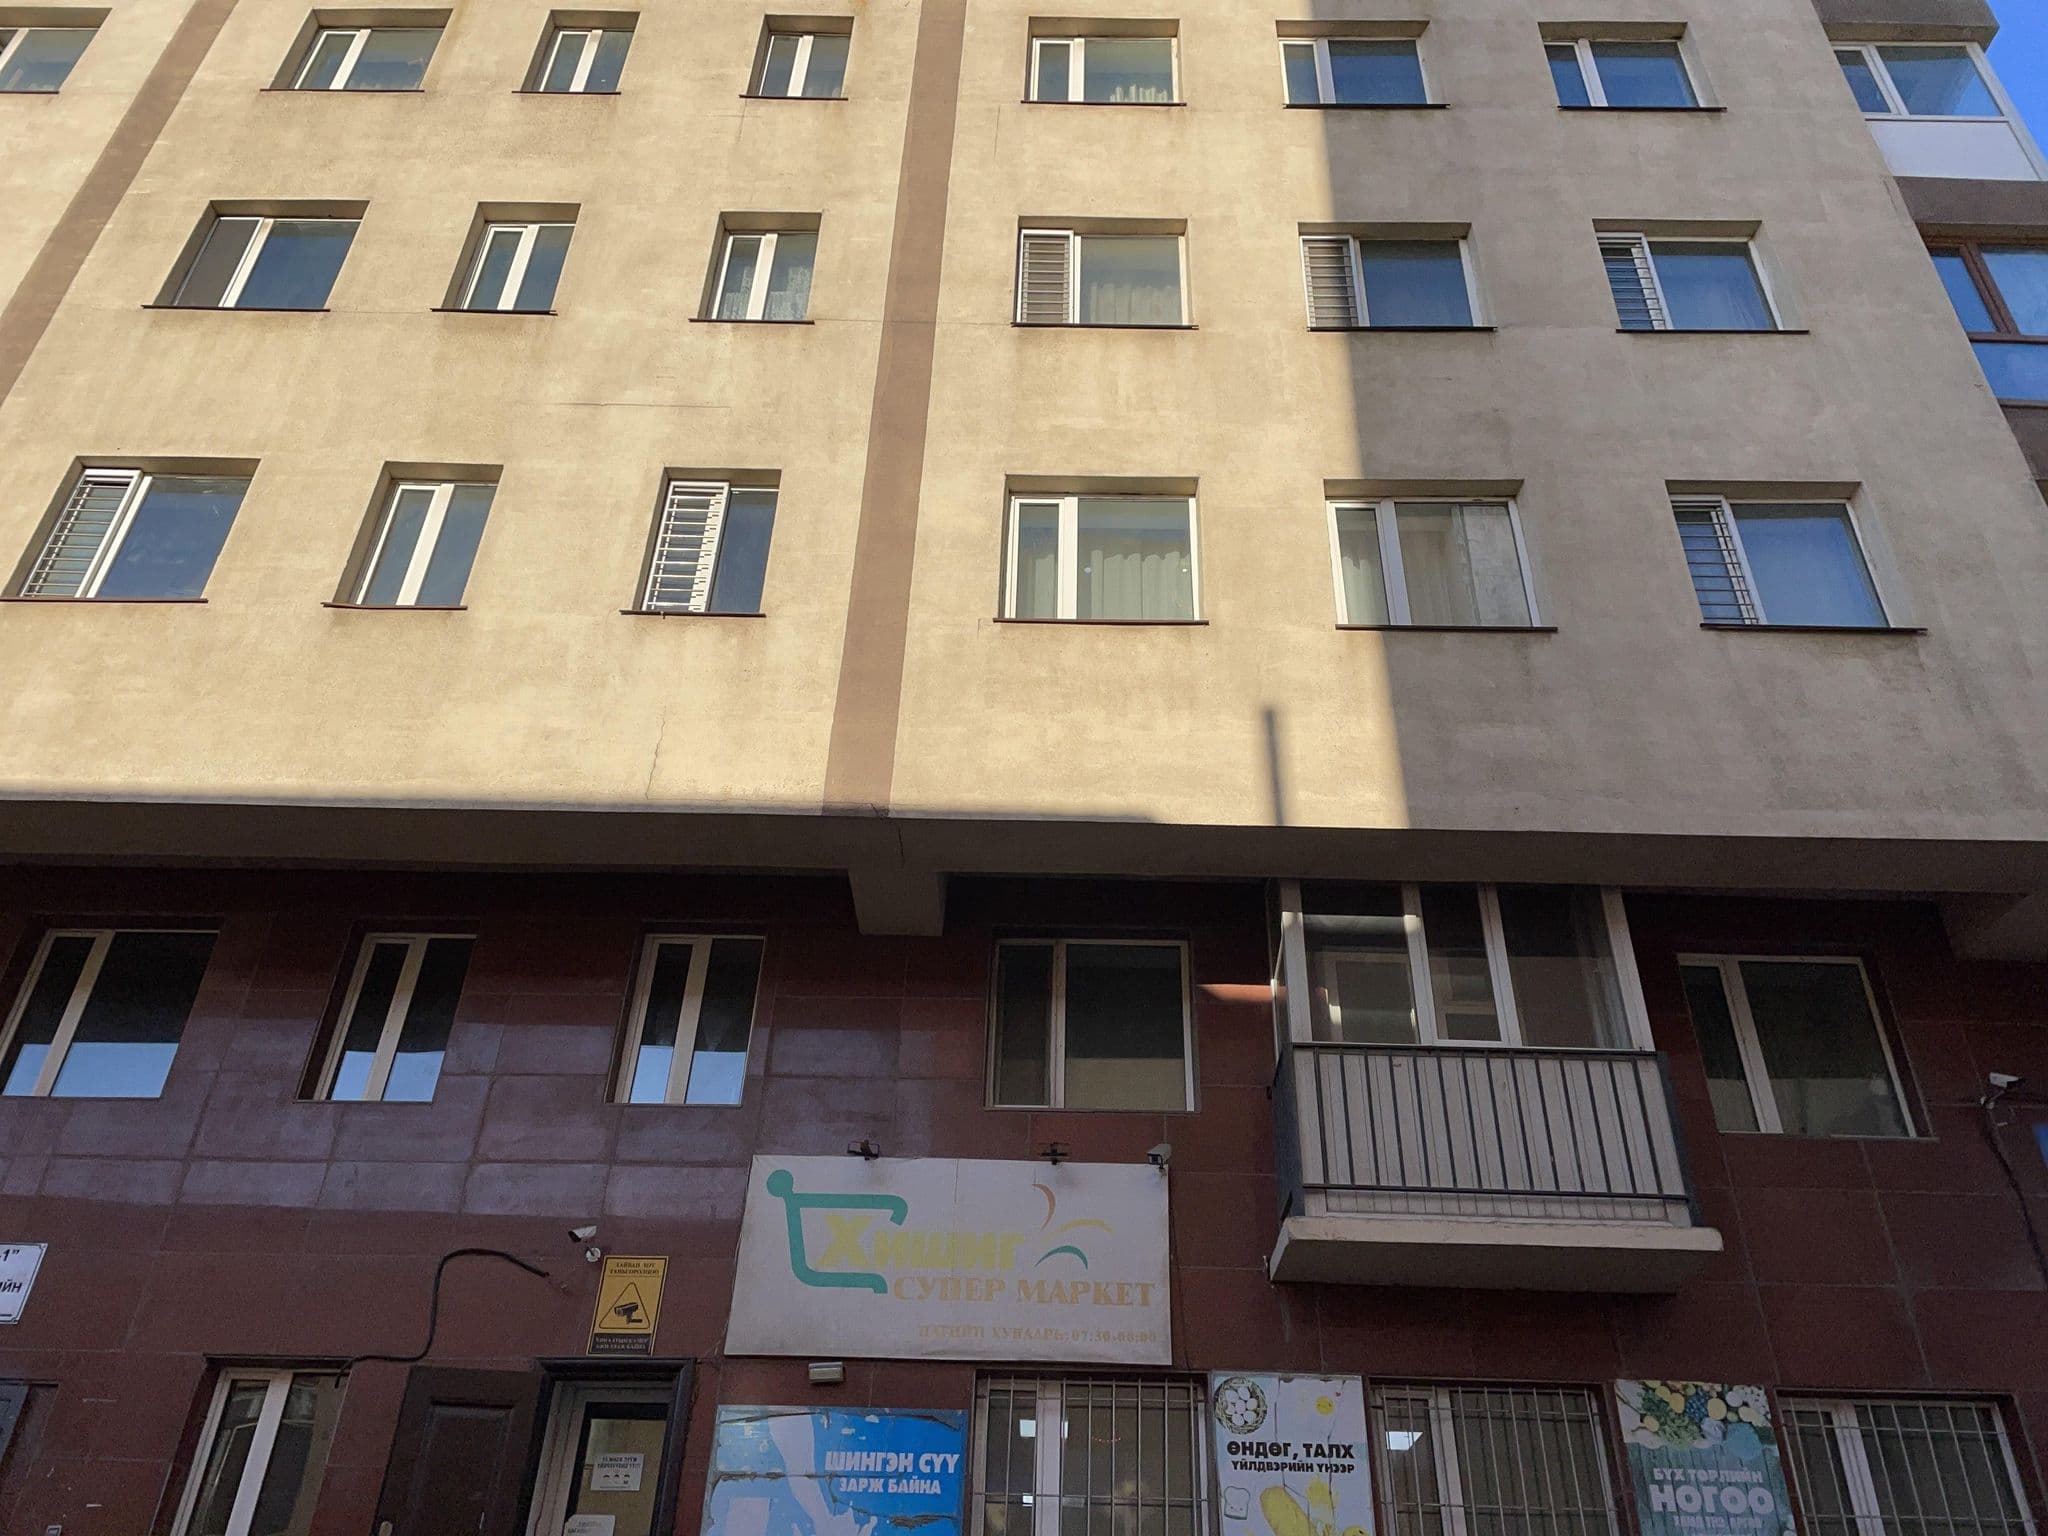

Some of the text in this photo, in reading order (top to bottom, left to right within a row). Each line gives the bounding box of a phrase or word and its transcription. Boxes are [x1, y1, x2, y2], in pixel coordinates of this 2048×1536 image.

[894, 1276, 1155, 1307] СУПЕР МАРКЕТ
[1227, 1440, 1355, 1460] ӨНДӨГ, ТАЛХ
[825, 1451, 960, 1474] ШИНГЭН СҮҮ
[1232, 1458, 1355, 1474] ҮЙЛДВЭРИЙН ҮНЭЭР
[839, 1475, 941, 1495] ЗАРЖ БАЙНА
[1650, 1484, 1776, 1515] НОГОО
